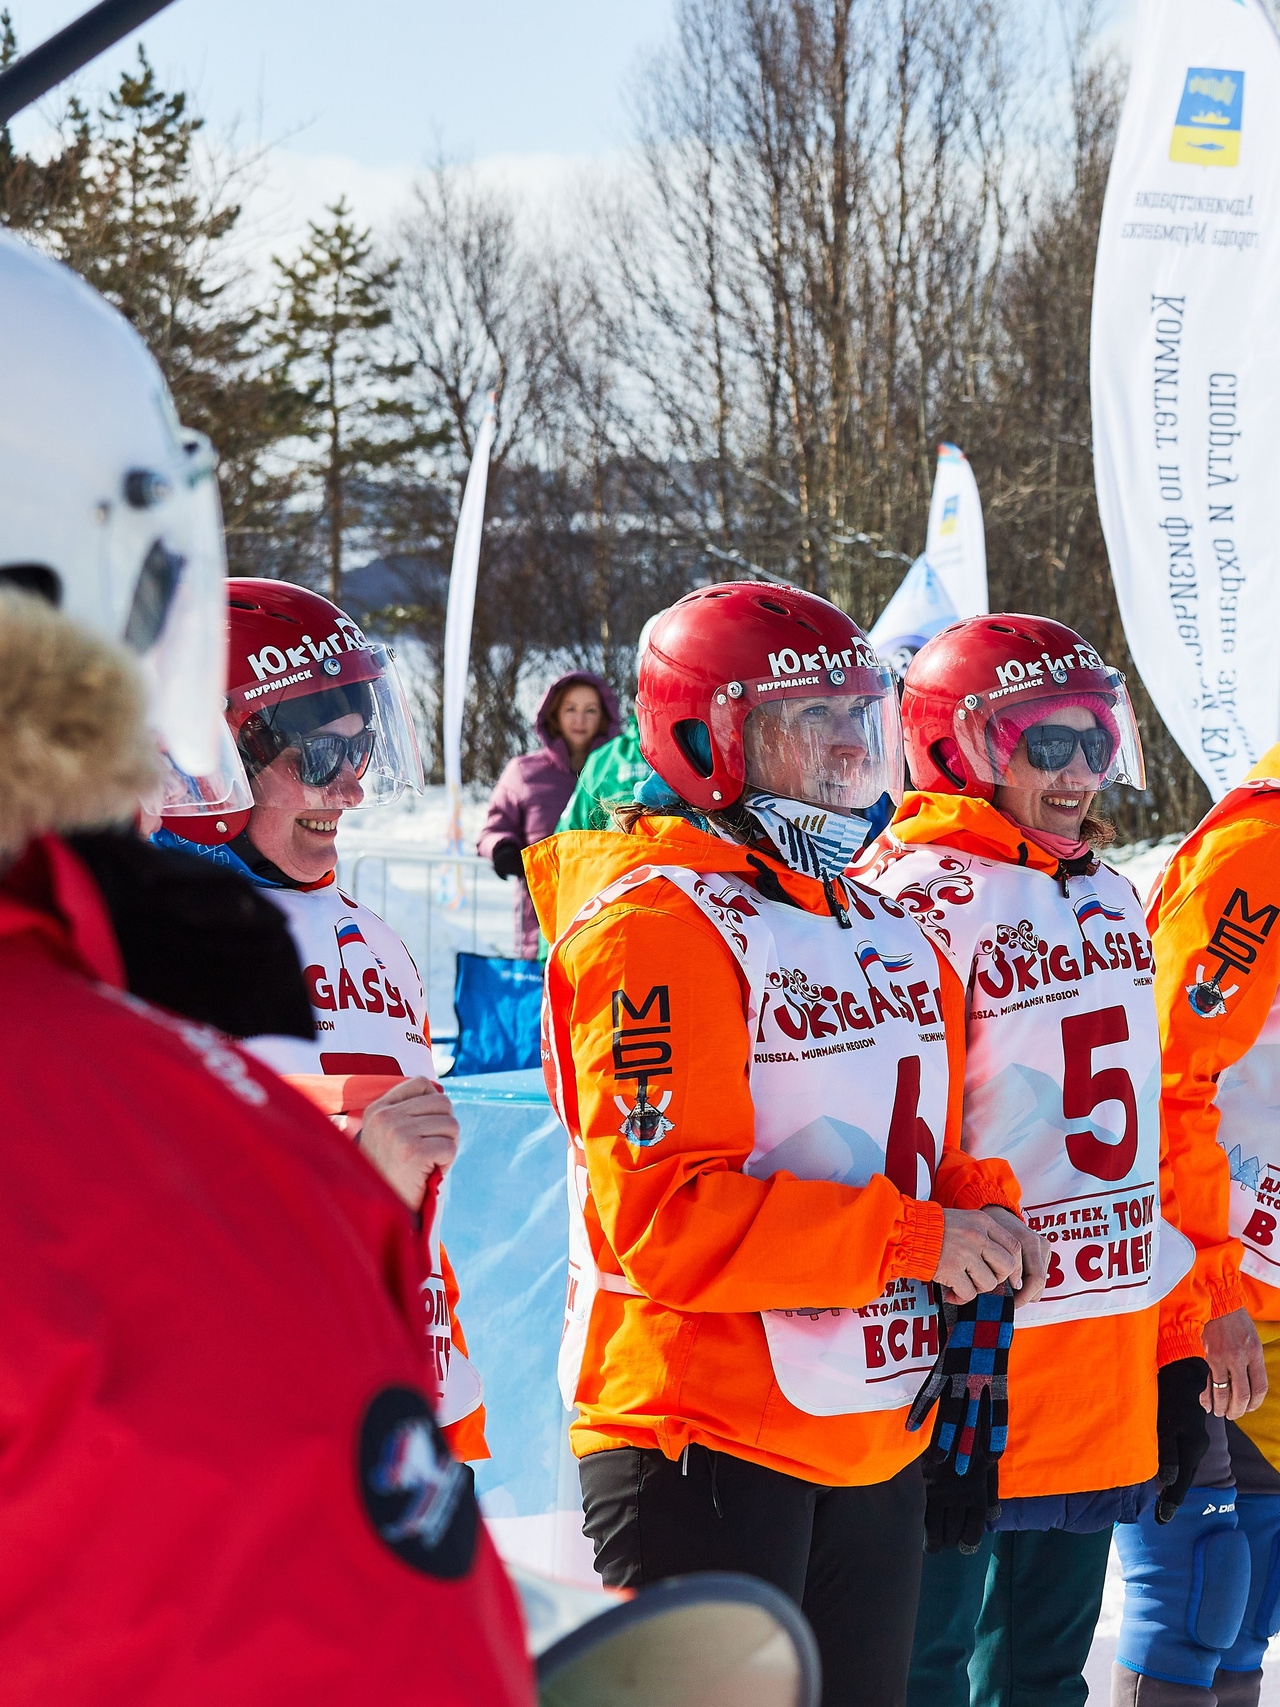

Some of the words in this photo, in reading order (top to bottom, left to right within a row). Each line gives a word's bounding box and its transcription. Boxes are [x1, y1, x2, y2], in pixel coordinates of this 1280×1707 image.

[244, 669, 313, 700] МУРМАНСК
[757, 676, 820, 692] МУРМАНСК
[989, 679, 1044, 700] МУРМАНСК
[1000, 995, 1044, 1016] MURMANSK
[1046, 989, 1080, 1003] REGION
[754, 1052, 799, 1063] RUSSIA,
[801, 1043, 845, 1060] MURMANSK
[845, 1037, 876, 1052] REGION
[1060, 1005, 1138, 1182] 5
[1028, 1212, 1066, 1231] ДЛЯ
[1070, 1206, 1107, 1223] ТЕХ,
[1242, 1208, 1277, 1246] В
[1062, 1224, 1109, 1241] ЗНАЕТ
[858, 1303, 889, 1318] КТО
[863, 1325, 886, 1368] В
